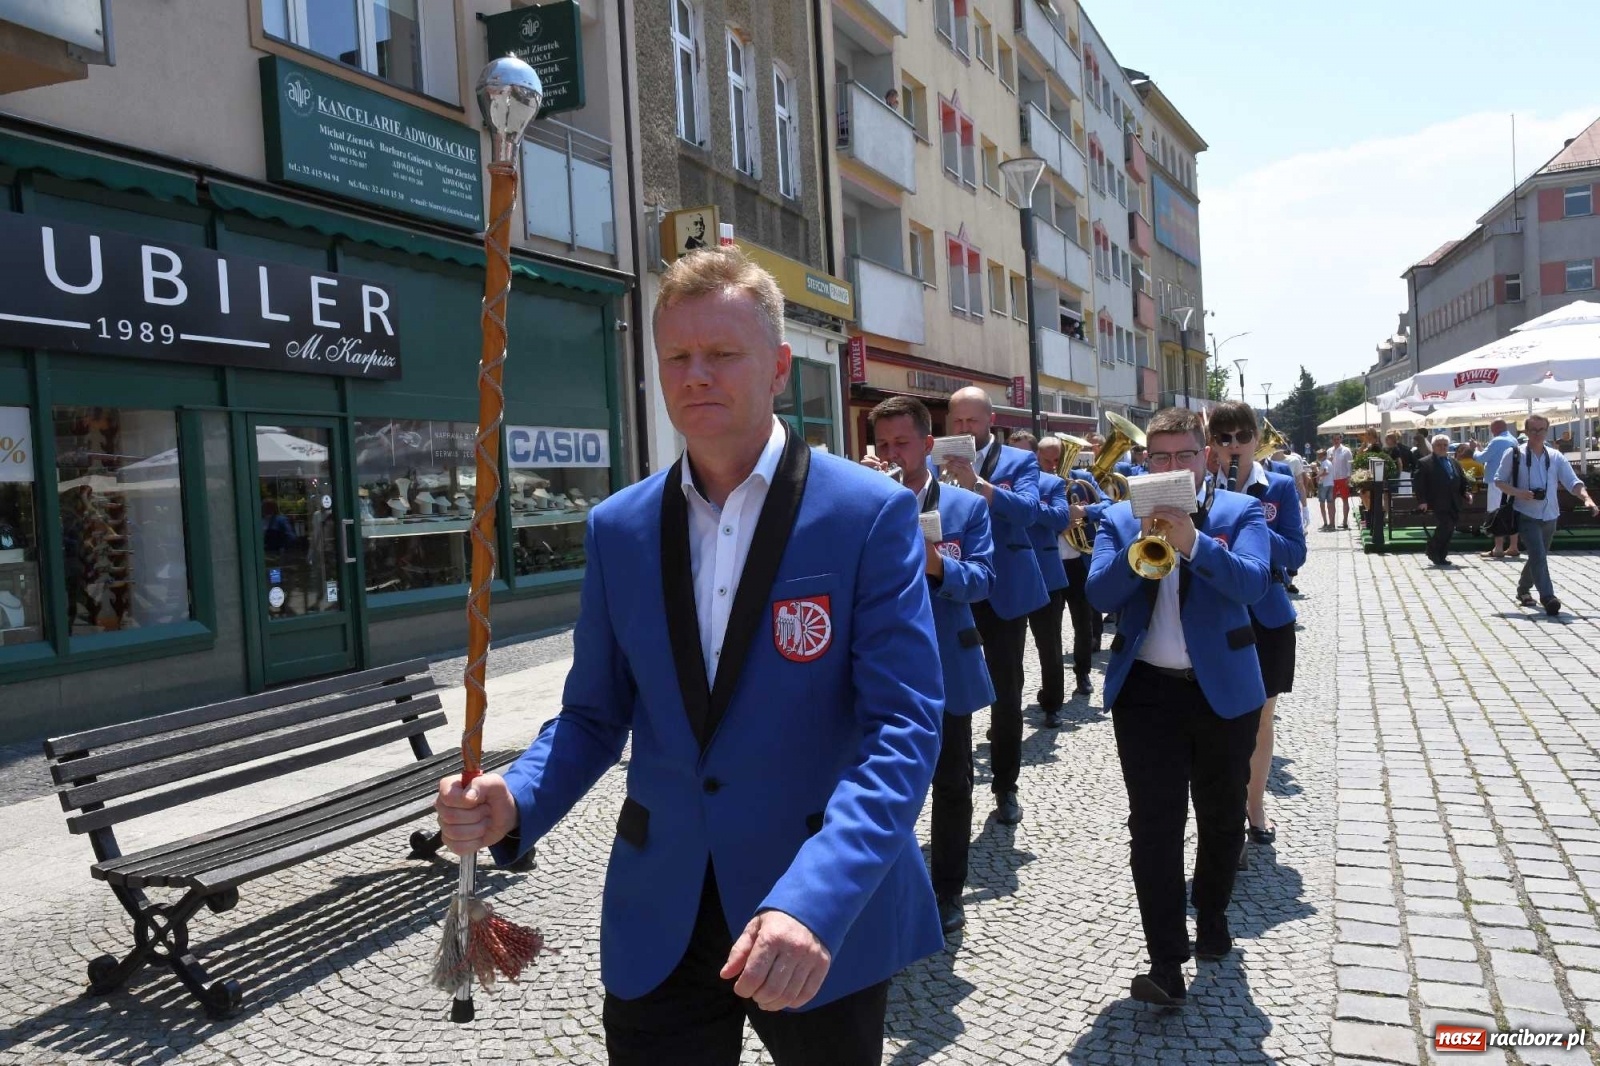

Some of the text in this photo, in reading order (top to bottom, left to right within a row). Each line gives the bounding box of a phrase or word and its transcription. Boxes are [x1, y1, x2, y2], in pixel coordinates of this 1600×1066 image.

[532, 40, 560, 52] Zientek
[524, 53, 552, 63] WOKAT
[318, 95, 477, 161] KANCELARIE ADWOKACKIE
[328, 142, 367, 159] ADWOKAT
[346, 133, 375, 149] Zientek
[379, 142, 433, 168] Barbara Gniewek
[302, 165, 310, 175] 32
[311, 168, 323, 179] 415
[371, 184, 379, 194] 32
[392, 161, 423, 177] ADWOKAT
[434, 162, 477, 182] Stefan Zientek
[441, 177, 473, 192] ADWOKAT
[42, 226, 394, 336] UBILER
[97, 317, 174, 345] 1989
[285, 333, 397, 374] M. Karpisz
[509, 430, 600, 463] CASIO
